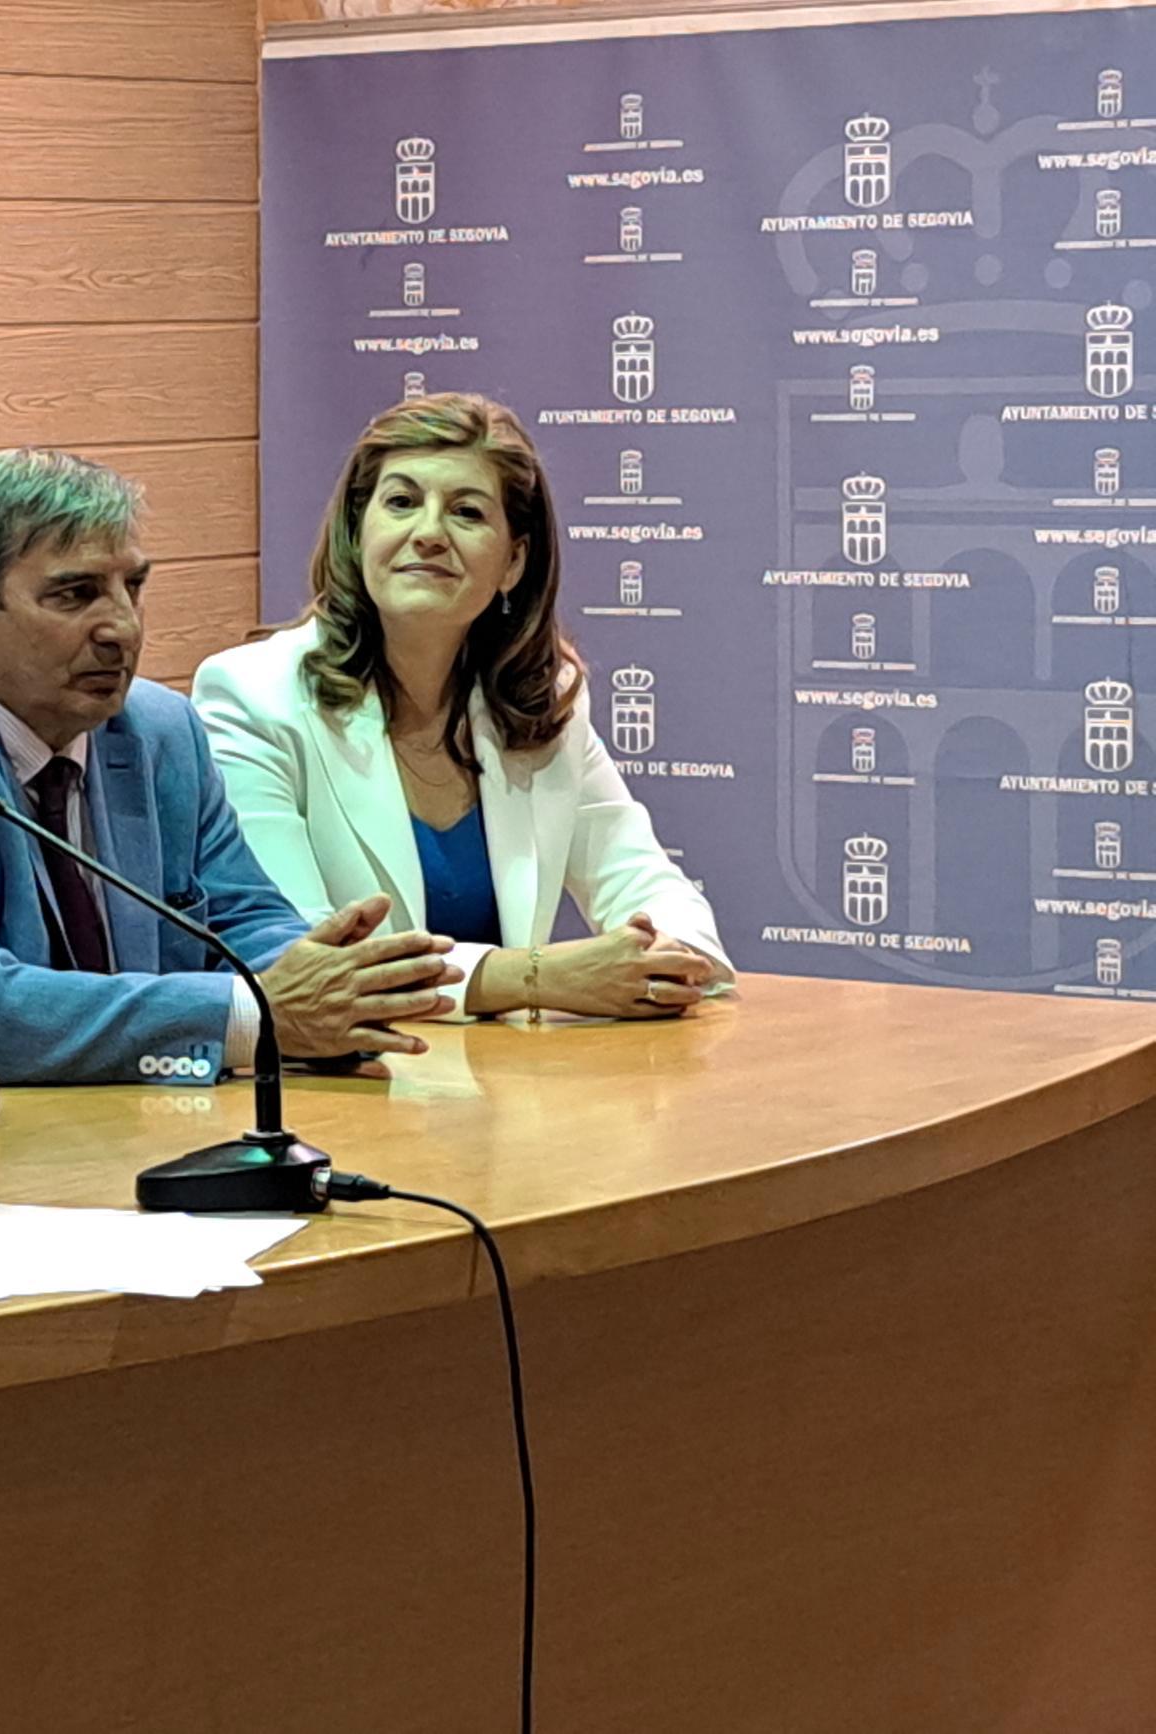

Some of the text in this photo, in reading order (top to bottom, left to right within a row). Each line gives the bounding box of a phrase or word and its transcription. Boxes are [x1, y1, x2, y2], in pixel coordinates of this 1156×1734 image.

[567, 166, 704, 190] www.segovia.es
[760, 210, 974, 232] AYUNTAMIENTO DE SEGOVIA
[324, 225, 509, 247] AYUNTAMIENTO DE SEGOVIA
[353, 333, 480, 355] www.segovia.es
[792, 324, 940, 347] www.segovia.es
[537, 407, 737, 425] AYUNTAMIENTO DE SEGOVIA
[1001, 404, 1120, 423] AYUNTAMIENTO
[1124, 404, 1148, 420] DE
[567, 521, 704, 544] www.segovia.es
[762, 570, 971, 589] AYUNTAMIENTO DE SEGOVIA
[794, 686, 939, 710] www.segovia.es
[647, 761, 668, 776] DE
[670, 761, 735, 779] SEGOVIA
[999, 774, 1120, 796] AYUNTAMIENTO
[1125, 780, 1148, 796] DE
[761, 925, 972, 955] AYUNTAMIENTO DE SEGOVIA
